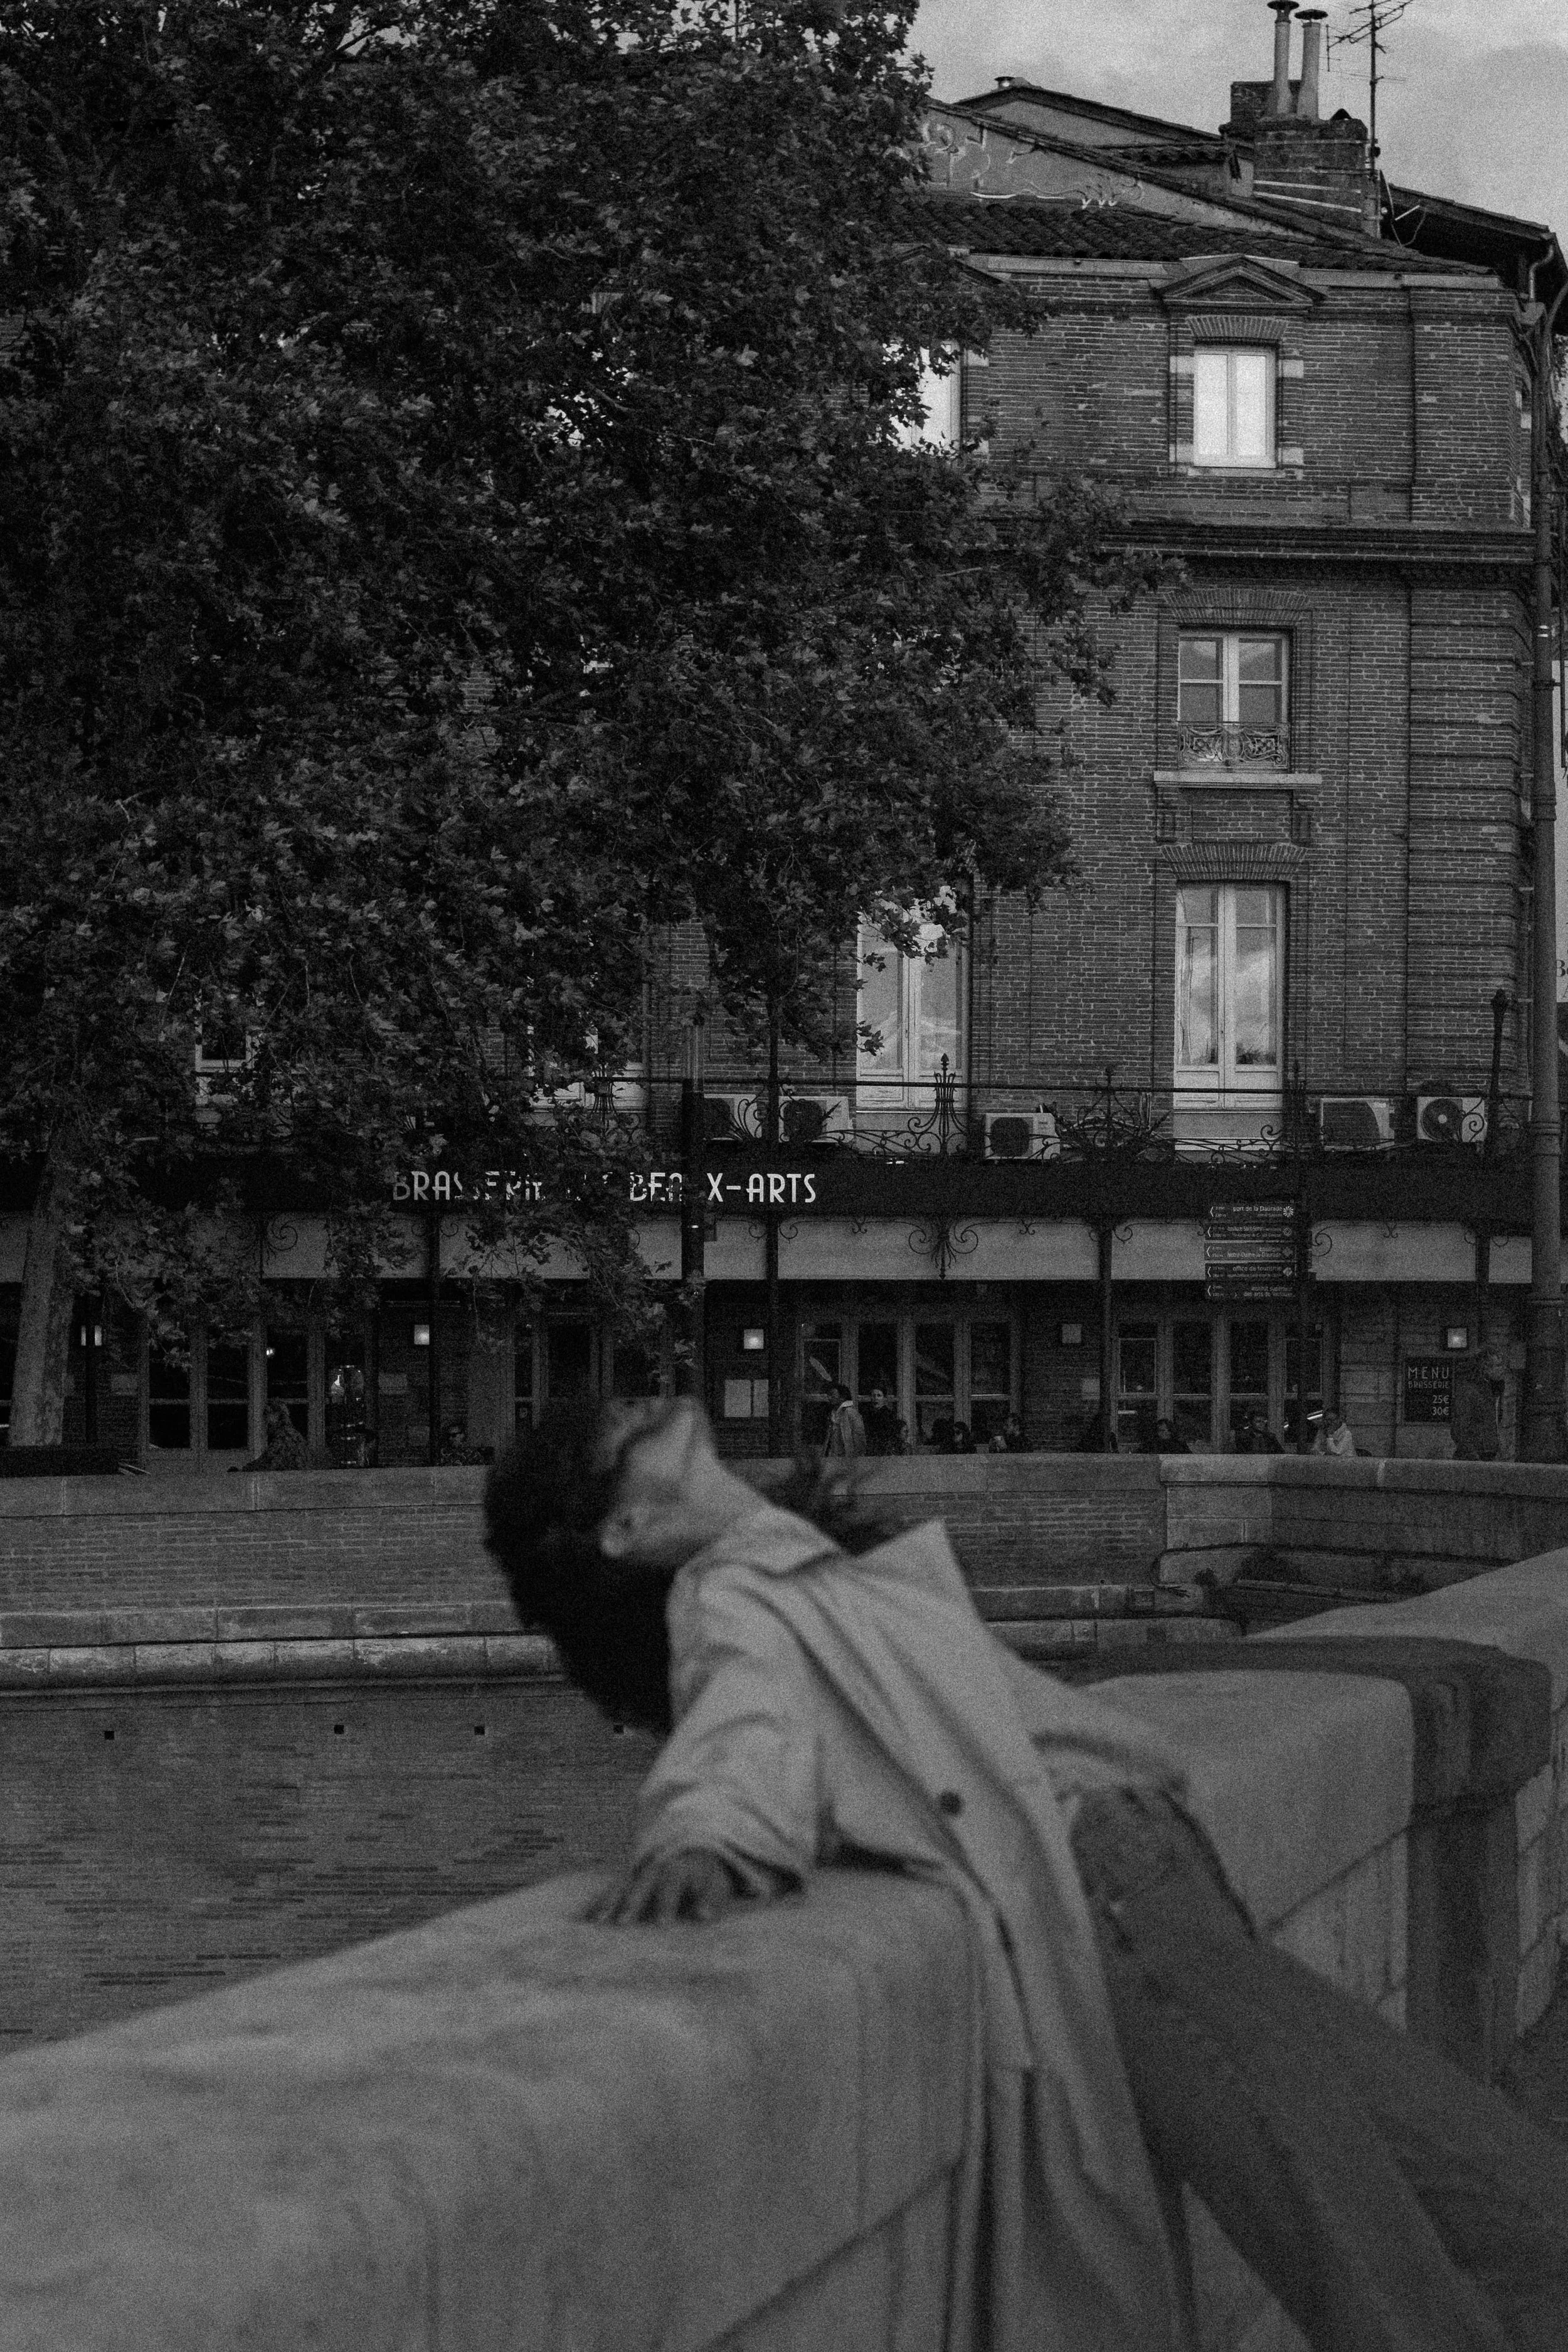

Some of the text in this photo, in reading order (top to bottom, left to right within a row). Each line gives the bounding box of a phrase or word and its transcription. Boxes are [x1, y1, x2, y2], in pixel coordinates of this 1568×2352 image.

[630, 1172, 815, 1203] BEAX-ARTS
[1408, 1367, 1449, 1379] MENU
[1433, 1395, 1449, 1404] 25€
[1432, 1407, 1449, 1416] 30€
